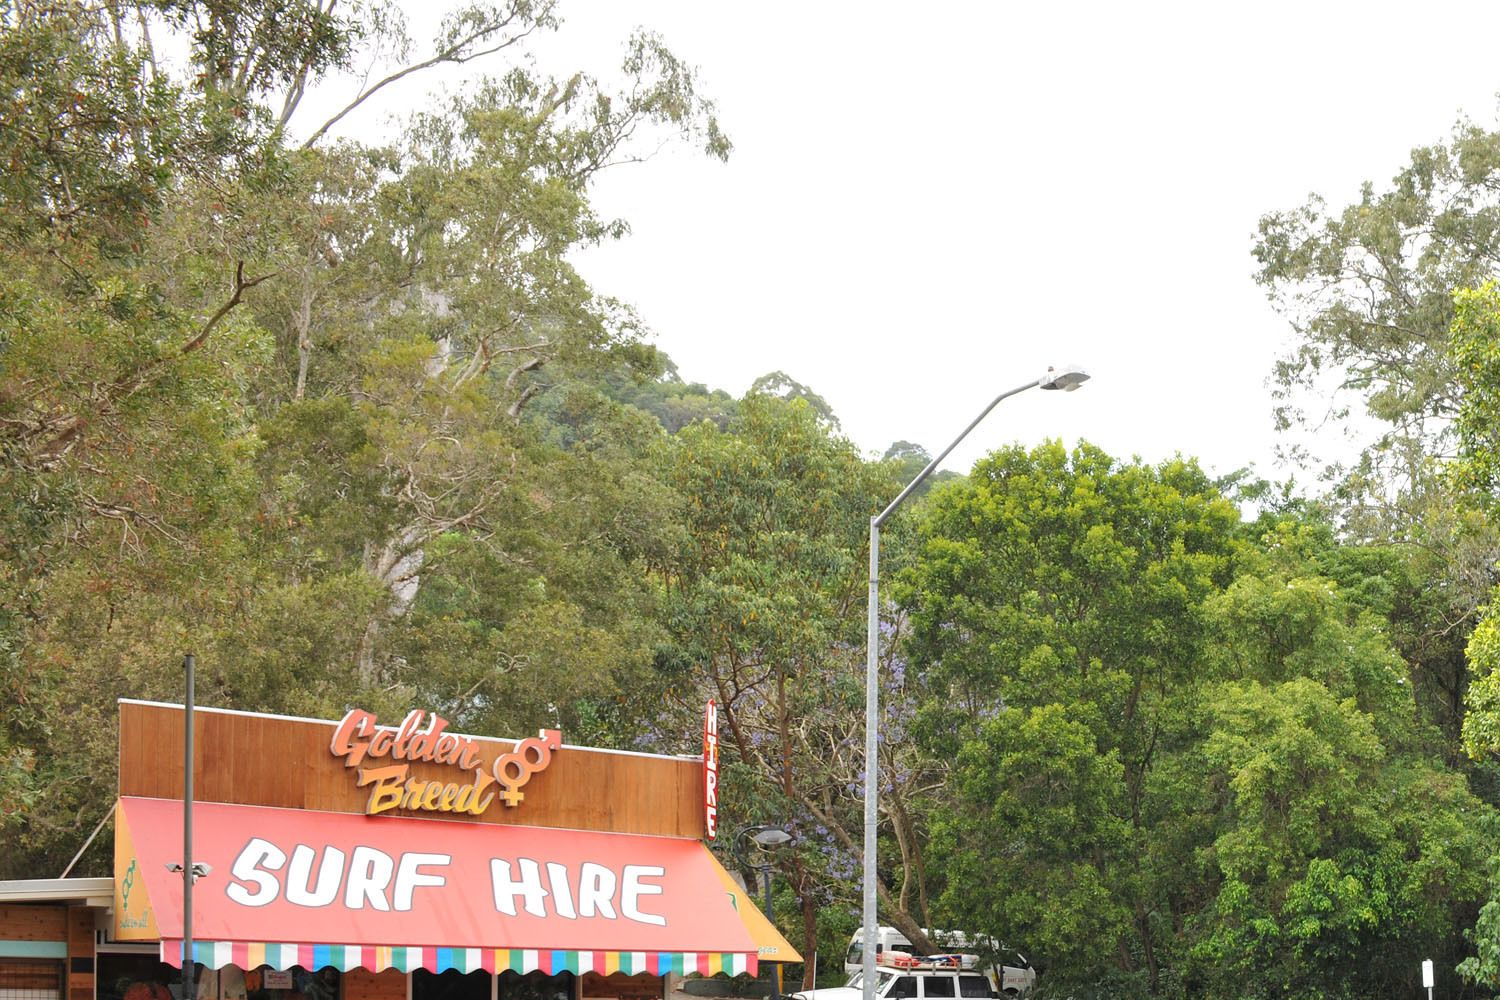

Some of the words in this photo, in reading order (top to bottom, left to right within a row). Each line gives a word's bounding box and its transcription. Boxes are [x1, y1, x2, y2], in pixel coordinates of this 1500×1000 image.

[330, 709, 481, 770] Golden
[706, 703, 717, 837] HIRE
[357, 764, 496, 815] Breed
[225, 837, 452, 912] SURF
[489, 857, 667, 927] HIRE
